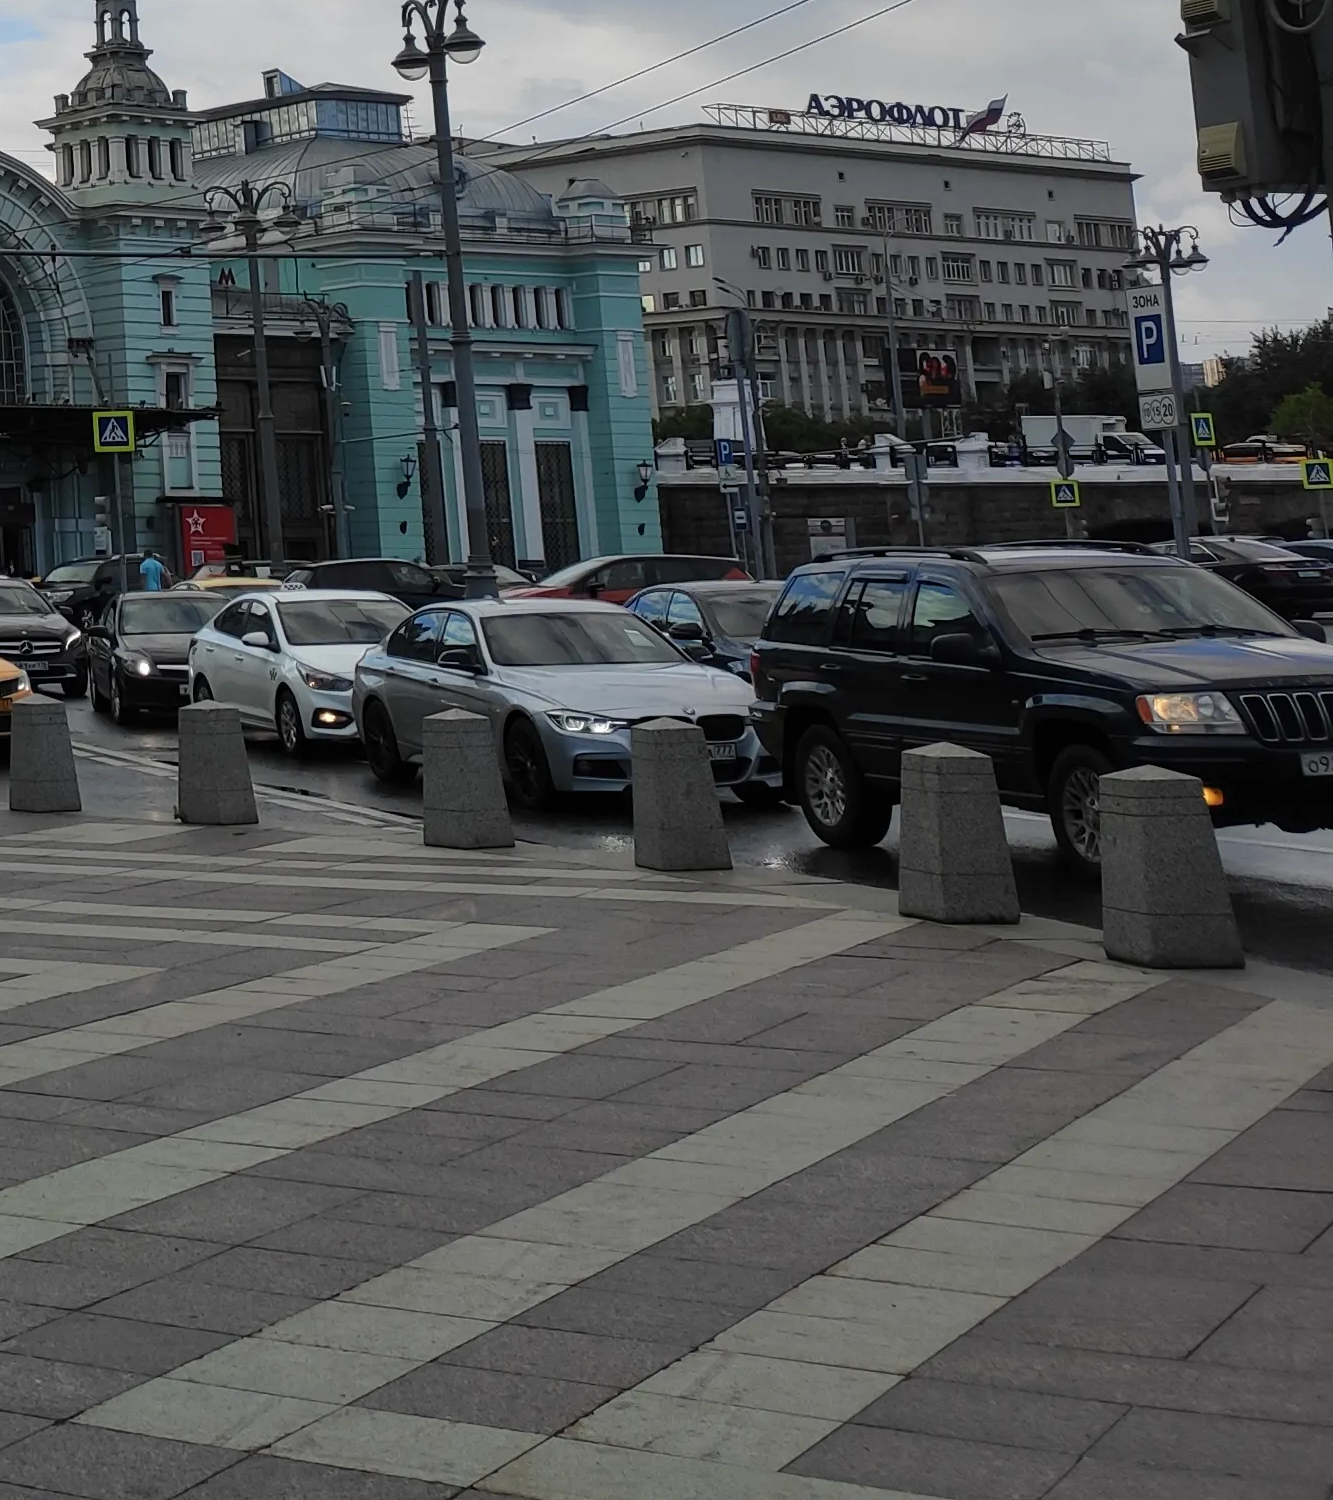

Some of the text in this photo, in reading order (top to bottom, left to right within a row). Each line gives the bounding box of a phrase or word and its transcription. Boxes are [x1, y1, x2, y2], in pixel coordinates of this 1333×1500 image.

[805, 93, 966, 130] АЭРОФЛОТ
[1132, 294, 1160, 309] ЗОНА
[1152, 405, 1161, 418] 15
[1162, 402, 1173, 418] 20
